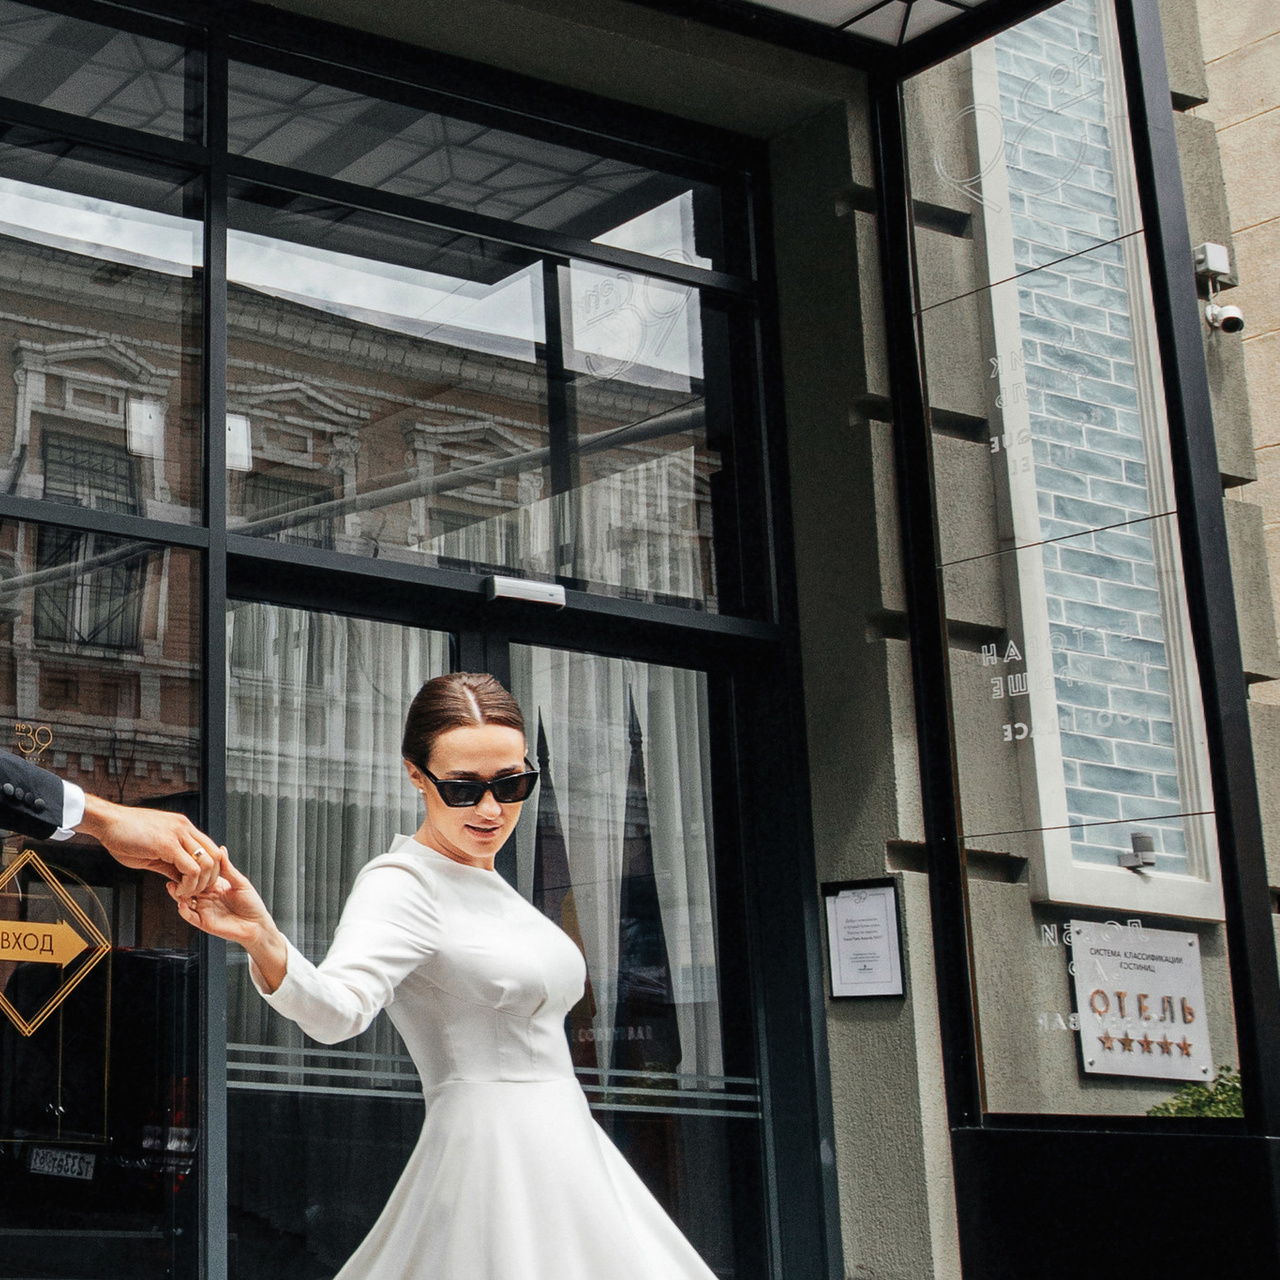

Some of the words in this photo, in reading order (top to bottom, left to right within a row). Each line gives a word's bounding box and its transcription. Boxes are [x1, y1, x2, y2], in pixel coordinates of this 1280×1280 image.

[0, 931, 54, 956] ВХОД
[1089, 947, 1121, 958] СИСТЕМА
[1123, 951, 1183, 965] КЛАССИФИКАЦИИ
[1119, 961, 1156, 973] ГОСТИНИЦ
[1090, 988, 1195, 1024] ОТЕЛЬ
